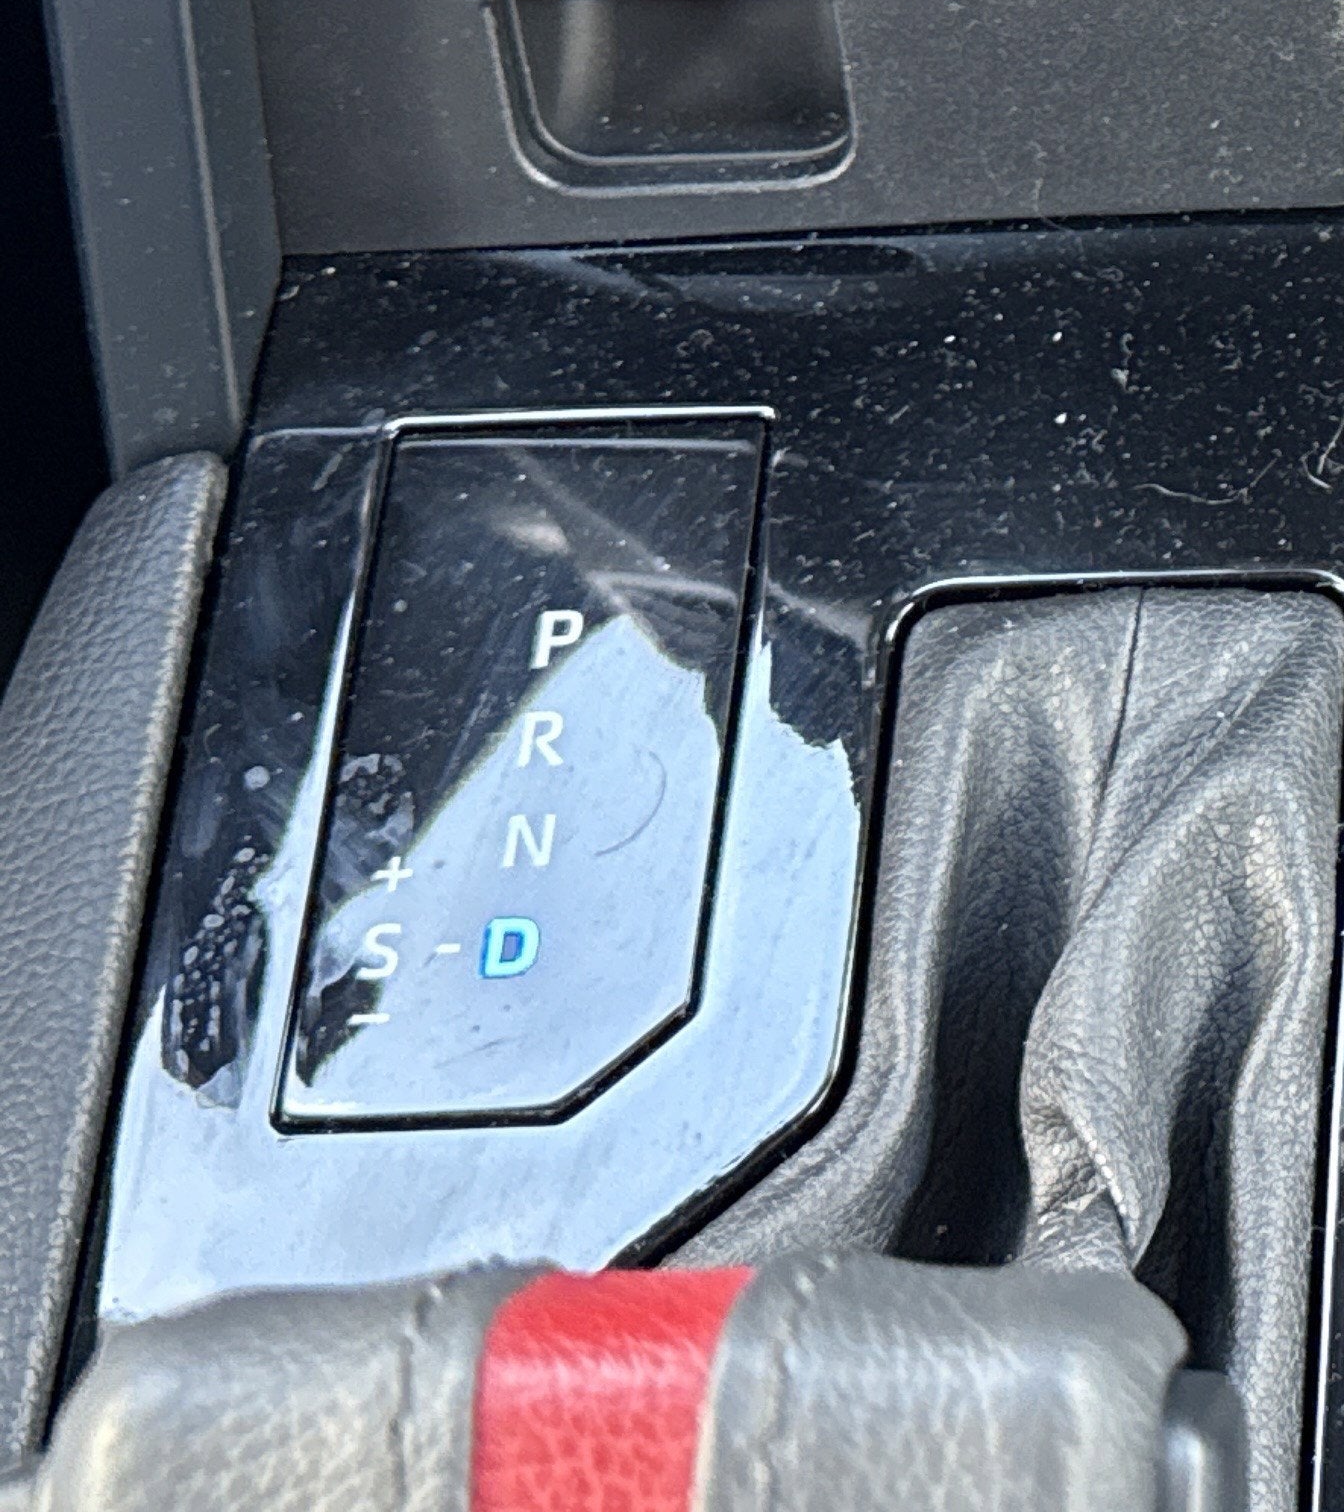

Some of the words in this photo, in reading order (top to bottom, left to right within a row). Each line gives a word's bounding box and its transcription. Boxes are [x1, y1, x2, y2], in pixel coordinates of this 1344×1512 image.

[529, 609, 584, 670] P
[517, 709, 565, 769] R
[502, 813, 557, 870] N
[355, 922, 402, 981] S
[478, 916, 540, 980] D
